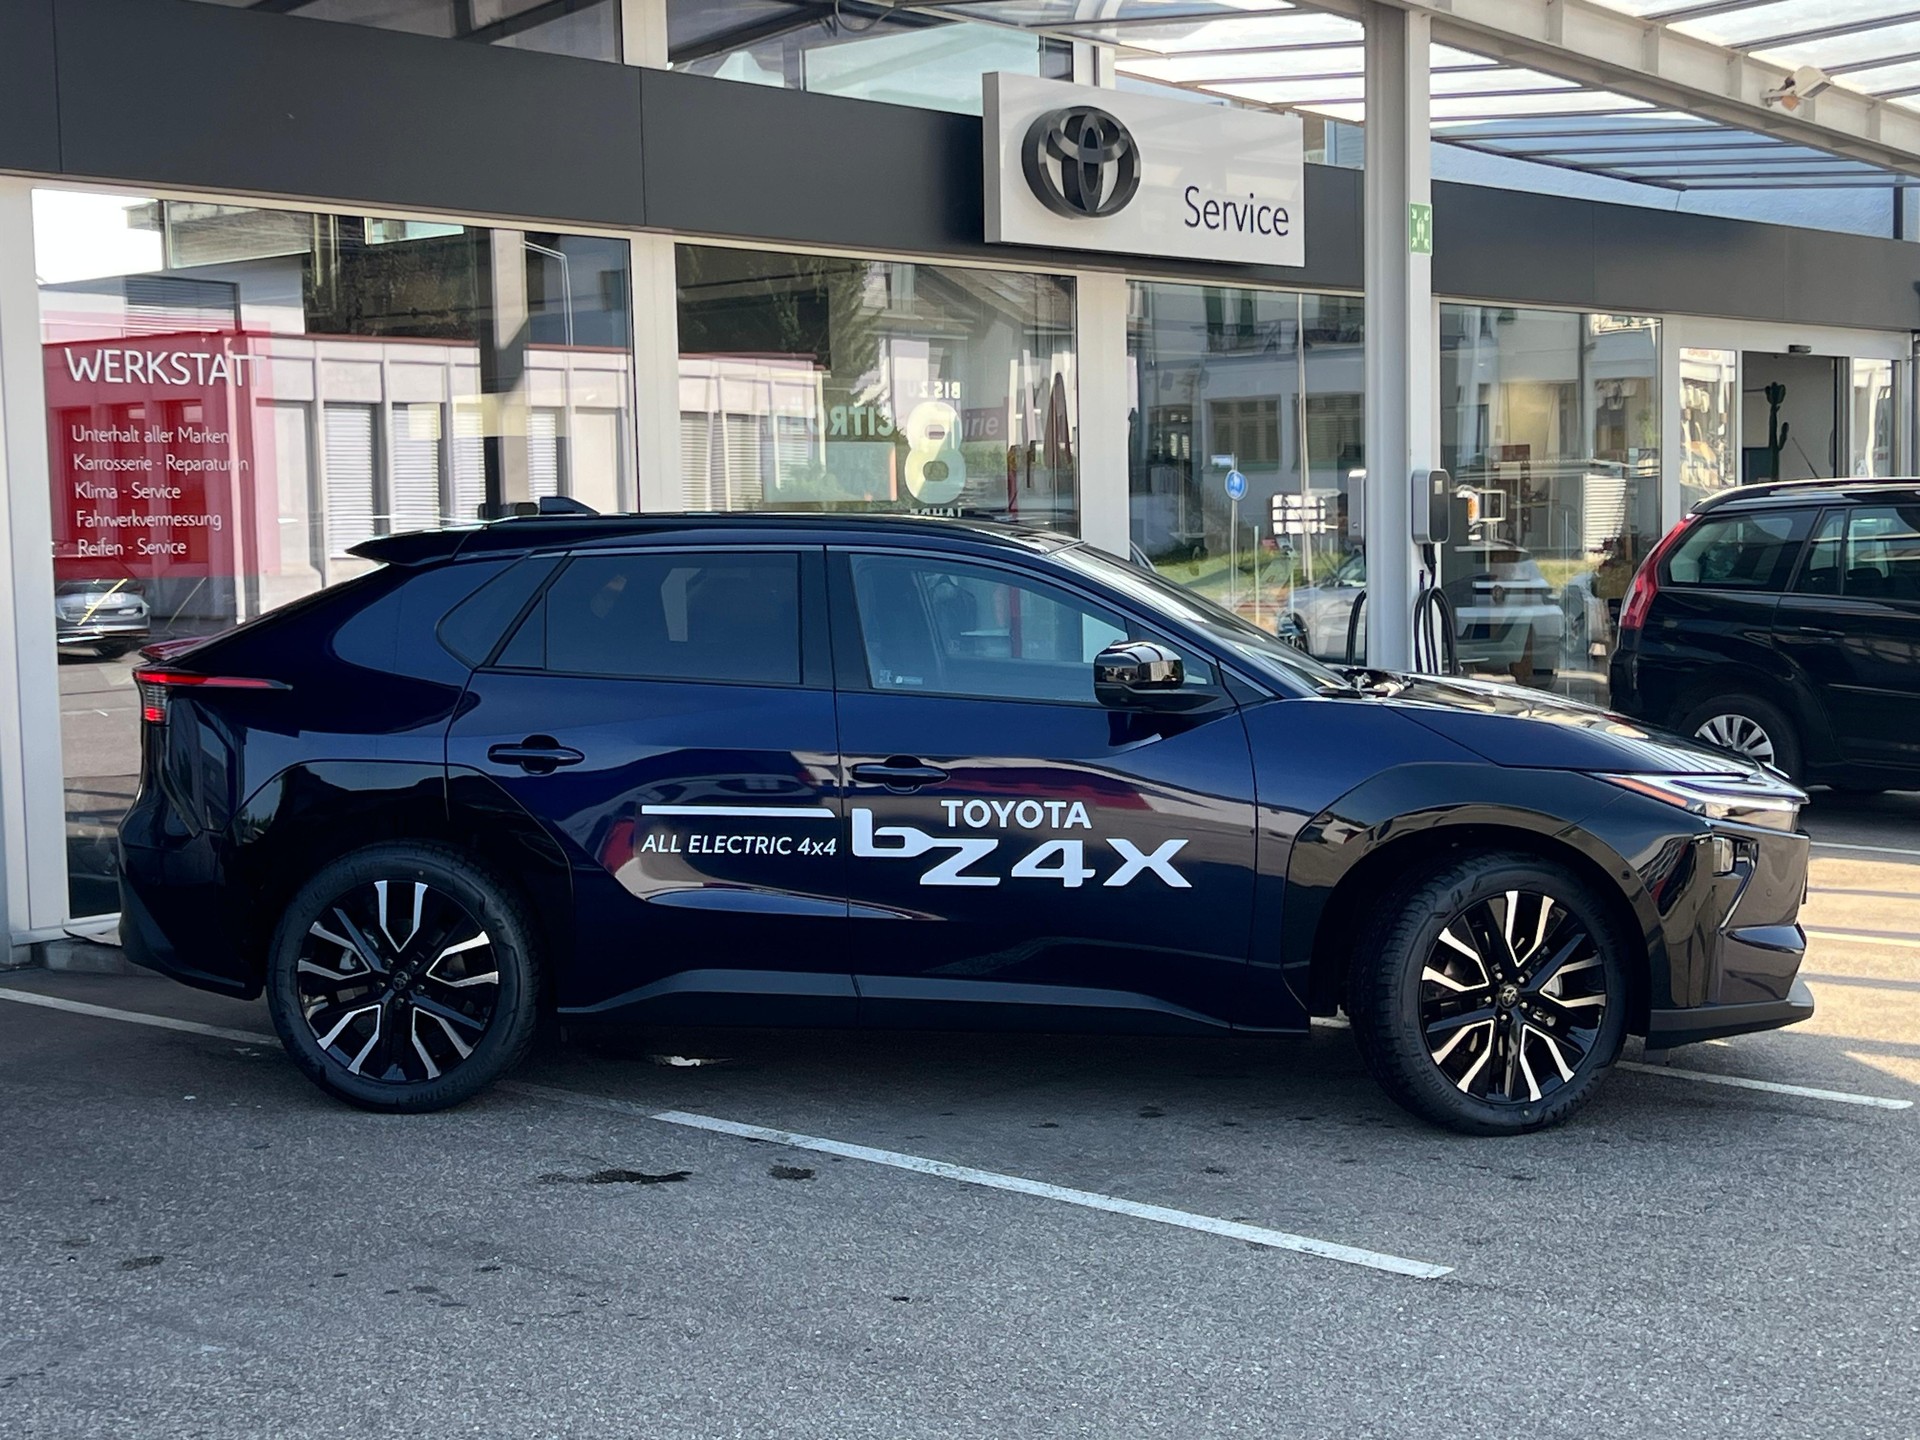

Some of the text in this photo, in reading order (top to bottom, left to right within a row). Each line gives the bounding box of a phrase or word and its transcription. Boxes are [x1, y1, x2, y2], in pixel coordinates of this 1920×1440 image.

[1184, 186, 1290, 236] Service
[72, 424, 230, 444] Unterhalt aller Marken
[73, 453, 152, 471] Karrosserie
[74, 481, 118, 499] Klima
[131, 481, 181, 499] Service
[76, 509, 222, 531] Fahrwerkvermessung
[77, 537, 124, 556] Reifen
[137, 537, 187, 555] Service
[940, 799, 1092, 829] TOYOTA
[641, 834, 837, 856] ALL ELECTRIC 4x4
